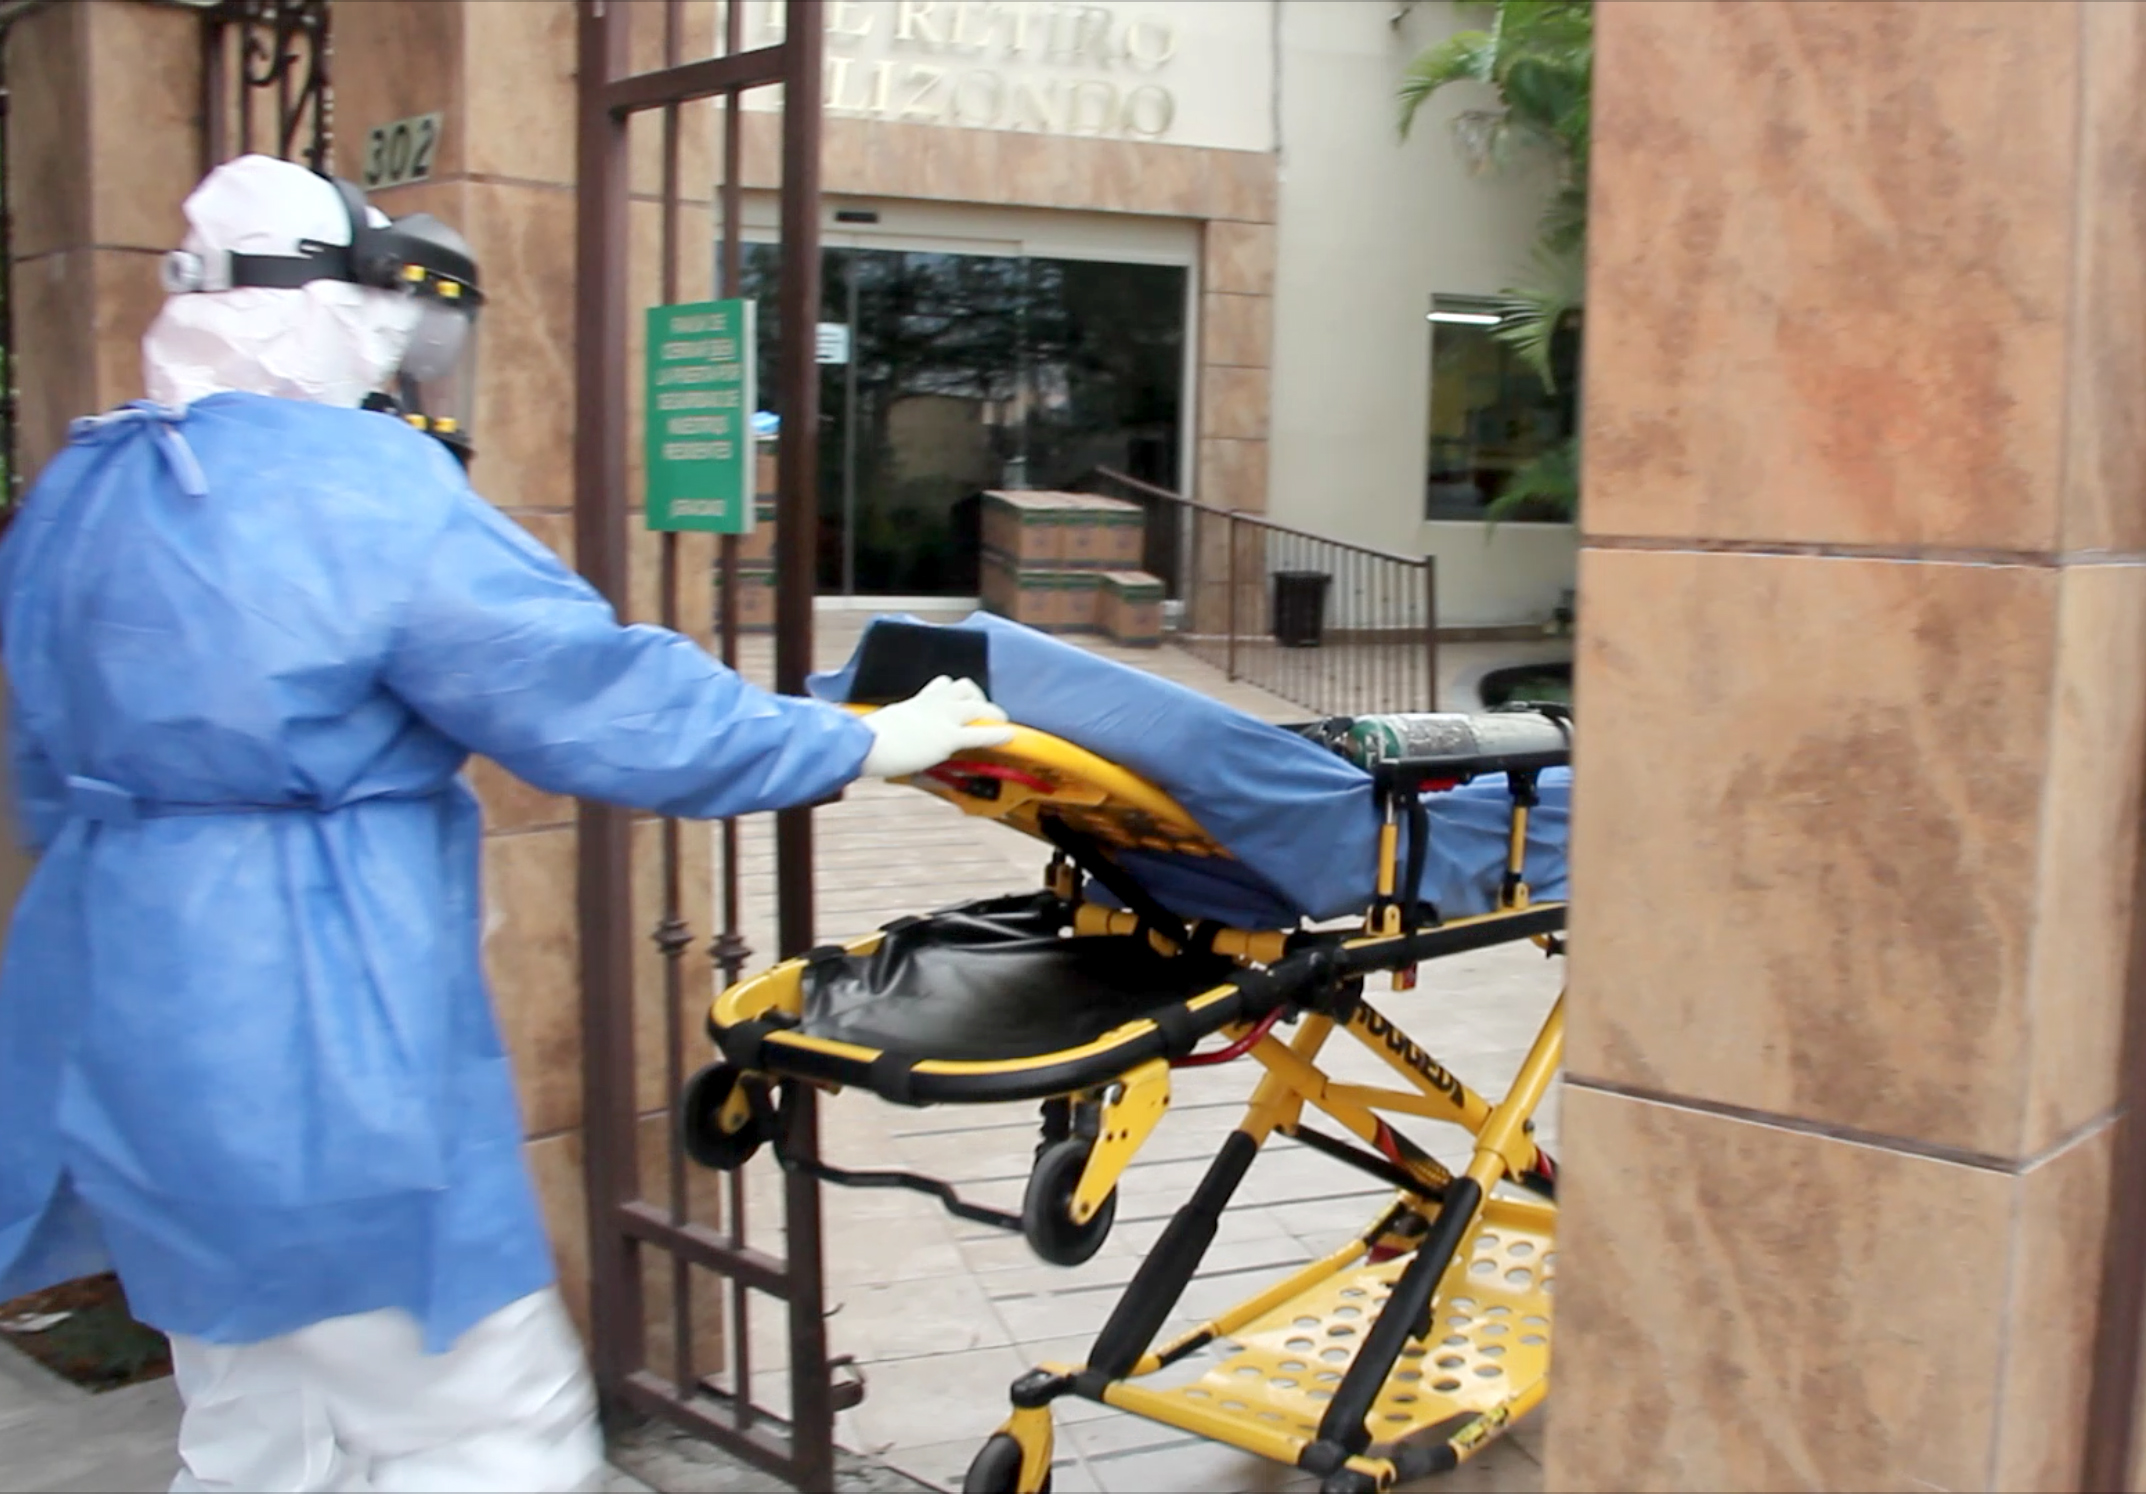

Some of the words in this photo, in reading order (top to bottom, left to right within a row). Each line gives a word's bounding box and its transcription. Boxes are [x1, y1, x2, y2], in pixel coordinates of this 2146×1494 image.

[894, 1, 1177, 72] RETIRO
[774, 57, 1177, 136] LIZONDO
[365, 118, 433, 186] 302
